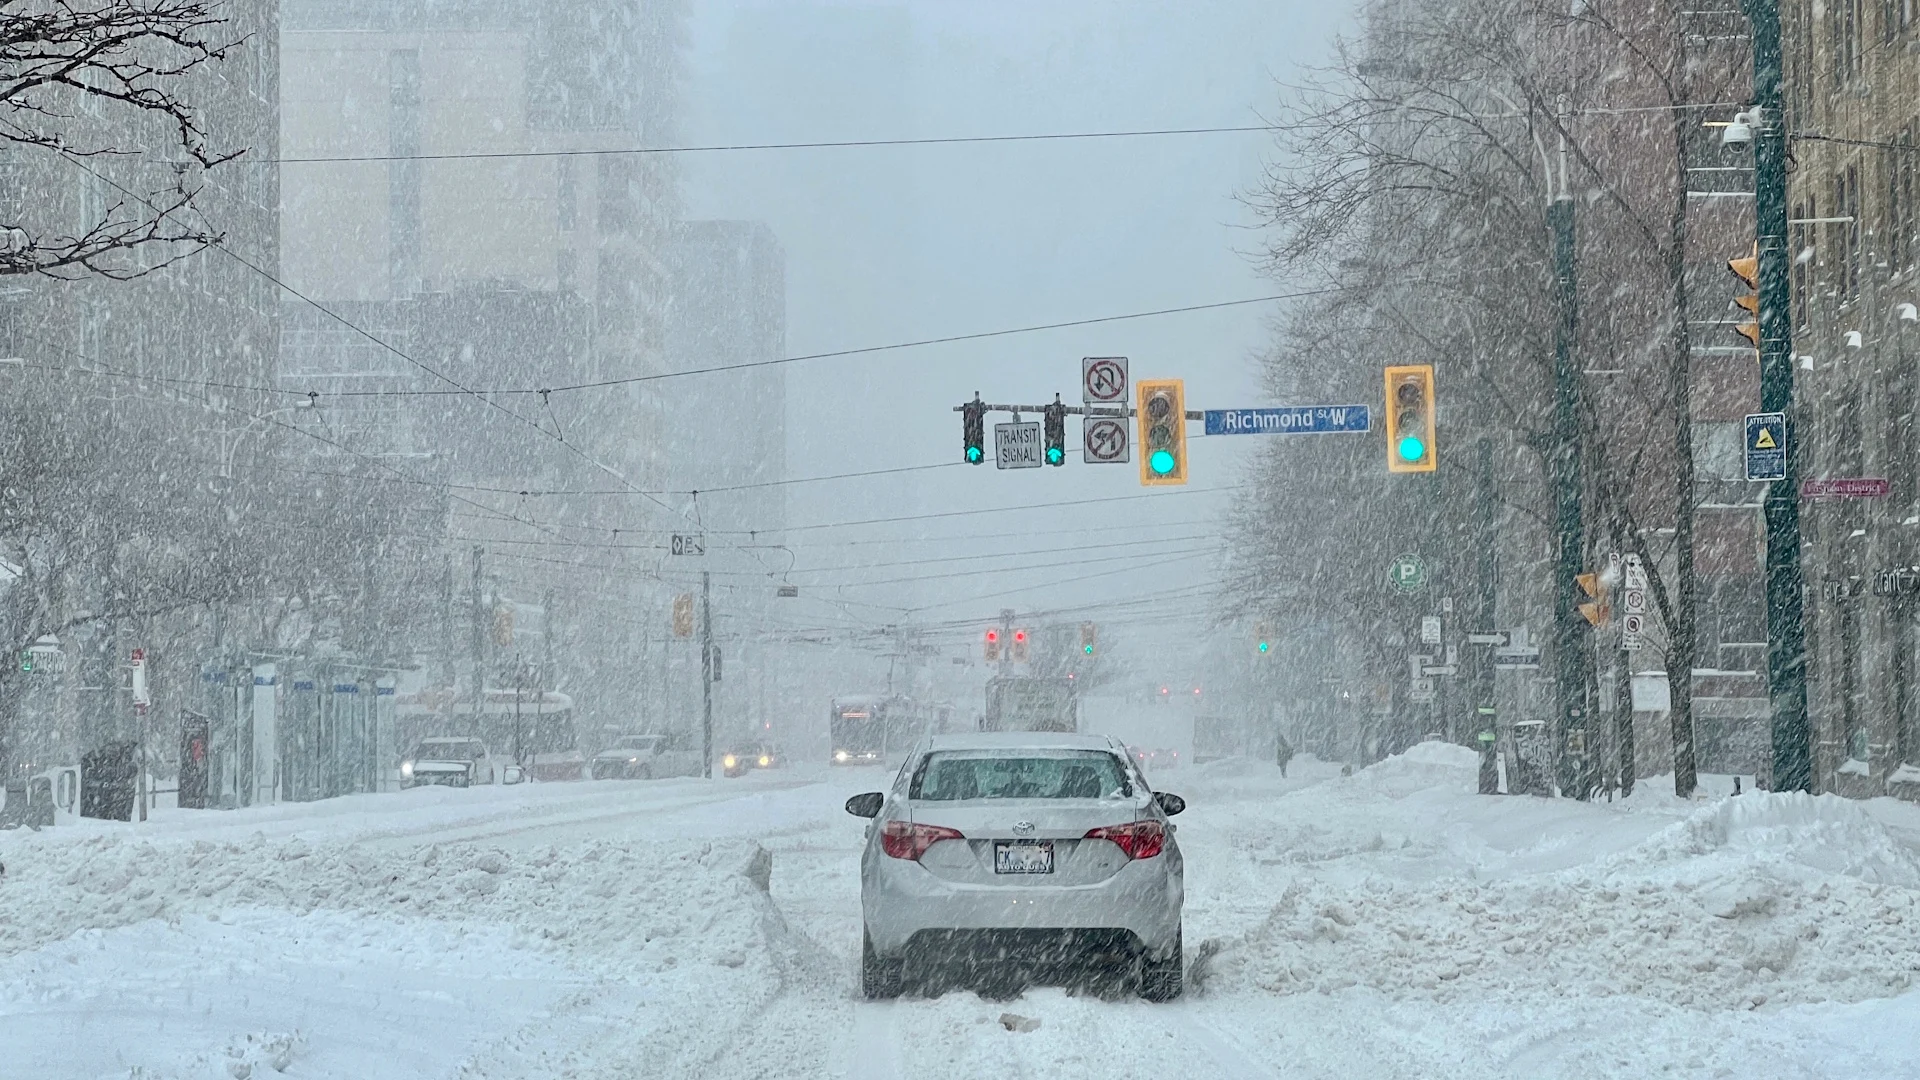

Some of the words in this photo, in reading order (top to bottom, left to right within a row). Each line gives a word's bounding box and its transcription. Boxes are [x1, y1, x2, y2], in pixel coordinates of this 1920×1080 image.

[1226, 409, 1313, 429] Richmond
[1331, 408, 1346, 426] W
[1749, 416, 1782, 425] ATTENTION
[997, 428, 1037, 445] TRANSIT
[1002, 447, 1036, 463] SIGNAL
[1847, 482, 1881, 493] District
